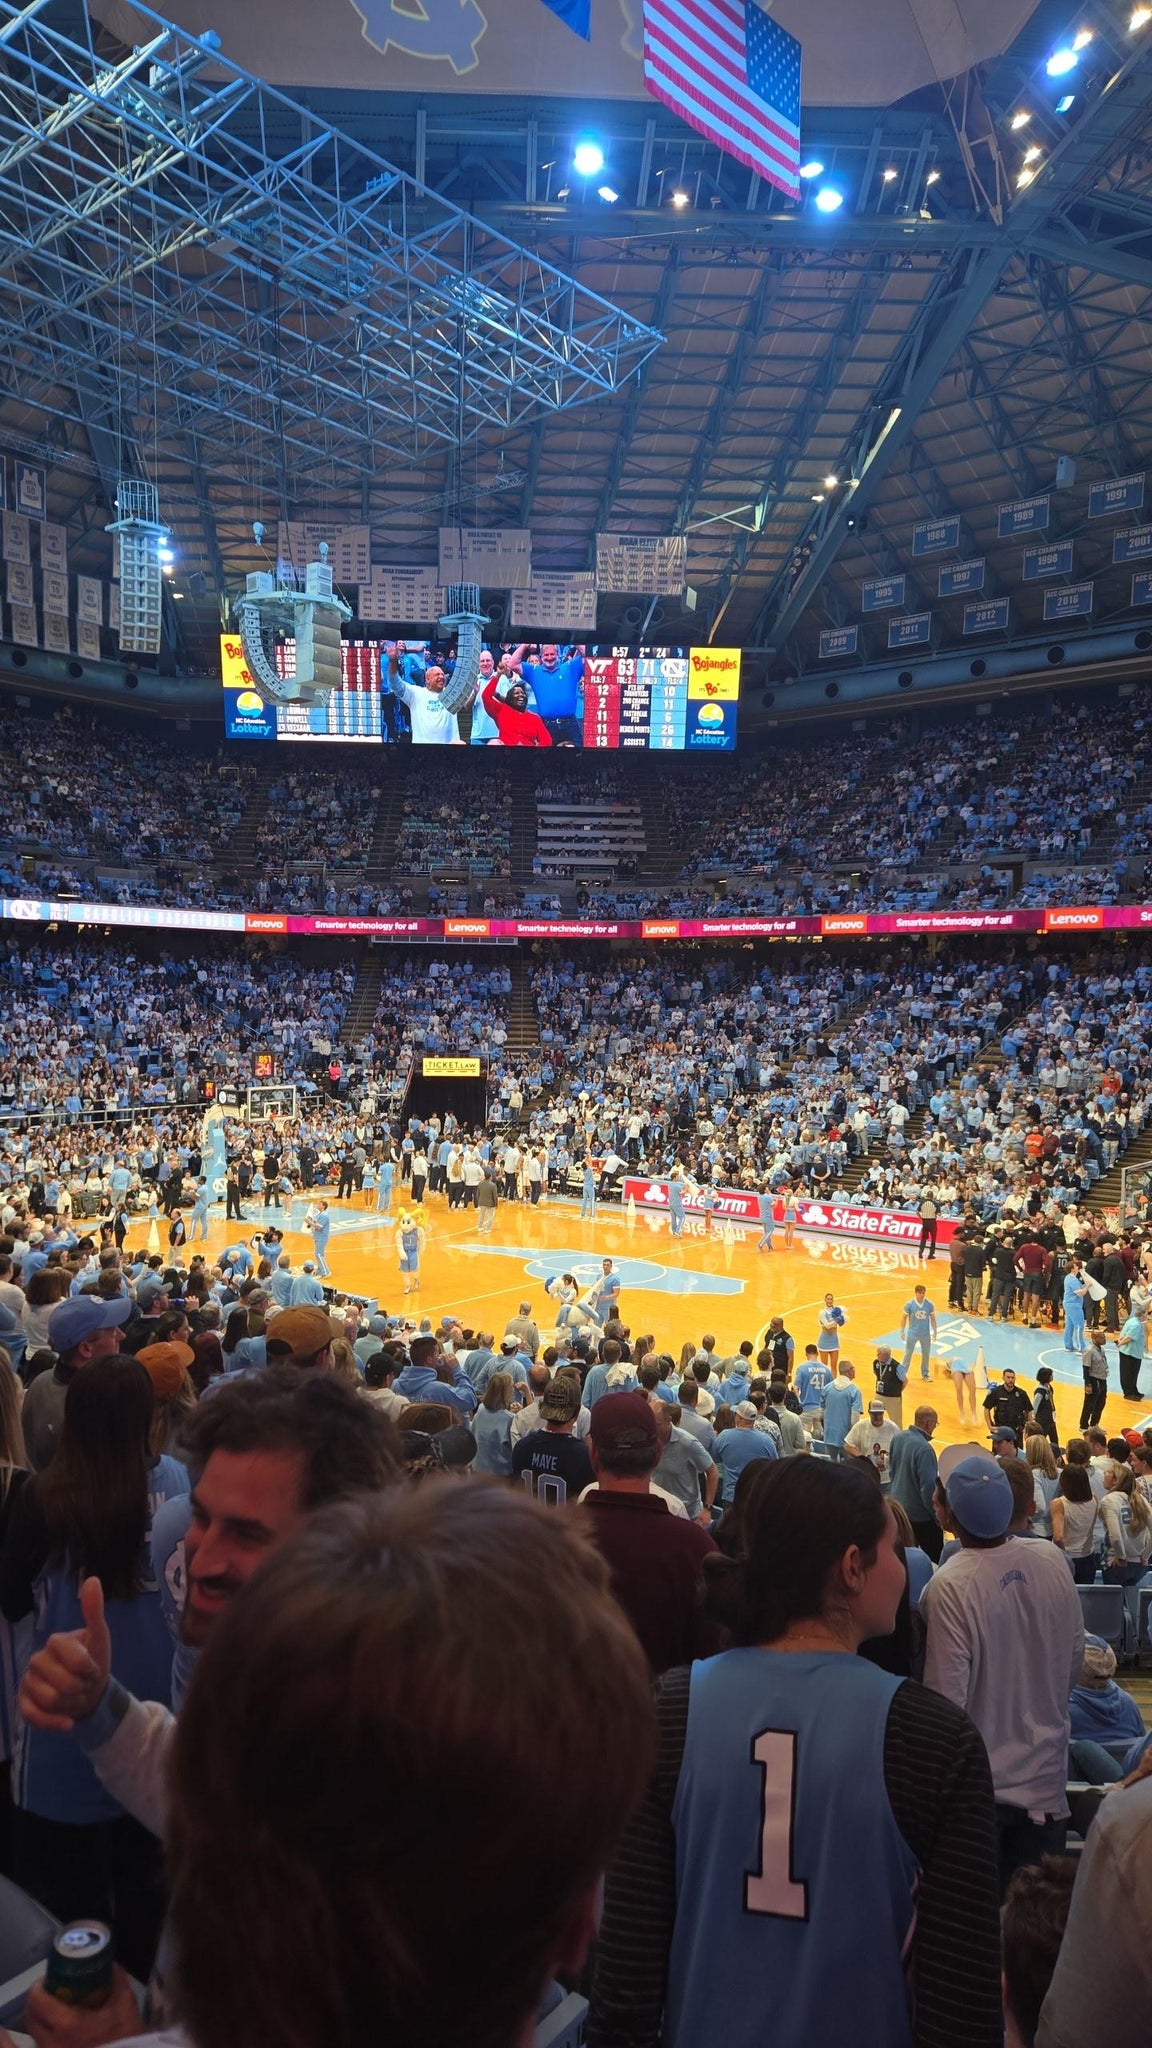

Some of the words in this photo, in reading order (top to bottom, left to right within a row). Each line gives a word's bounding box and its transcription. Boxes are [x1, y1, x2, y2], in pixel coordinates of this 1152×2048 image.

[1106, 488, 1126, 501] 1991
[928, 529, 946, 541] 1988
[1129, 535, 1150, 548] 2001
[1038, 554, 1058, 565] 1998
[953, 571, 970, 582] 1997
[875, 586, 892, 598] 1995
[976, 610, 996, 621] 2012
[342, 648, 348, 656] 3
[656, 648, 667, 658] 24
[618, 658, 634, 676] 63
[642, 660, 655, 676] 71
[691, 656, 737, 672] Bojangles
[598, 684, 609, 696] 12
[664, 686, 675, 696] 10
[600, 698, 606, 708] 2
[664, 700, 673, 710] 11
[597, 711, 607, 721] 11
[664, 712, 672, 722] 6
[231, 723, 271, 735] Lottery
[597, 724, 607, 734] 11
[596, 736, 608, 747] 13
[690, 734, 729, 746] Lottery
[247, 918, 283, 929] Lenovo
[896, 918, 931, 927] Smarter
[932, 917, 983, 927] technology
[984, 916, 998, 925] for
[999, 915, 1013, 924] all
[1050, 913, 1098, 924] Lenovo
[315, 921, 347, 930] Smarter
[348, 921, 393, 931] technology
[395, 921, 407, 930] for
[408, 922, 418, 930] all
[448, 923, 486, 933] Lenovo
[517, 924, 549, 933] Smarter
[550, 924, 594, 934] technology
[595, 925, 607, 933] for
[608, 925, 617, 933] all
[645, 925, 677, 934] Lenovo
[703, 924, 731, 932] Smarter
[732, 923, 773, 932] technology
[774, 922, 786, 931] for
[825, 919, 863, 930] Lenovo
[255, 1064, 272, 1076] 24
[830, 1208, 879, 1231] State
[880, 1214, 923, 1237] Farm
[1058, 1258, 1067, 1268] 10
[810, 1374, 826, 1390] 41
[532, 1452, 558, 1471] MAYE
[521, 1469, 567, 1507] 10
[743, 1728, 809, 1922] 1
